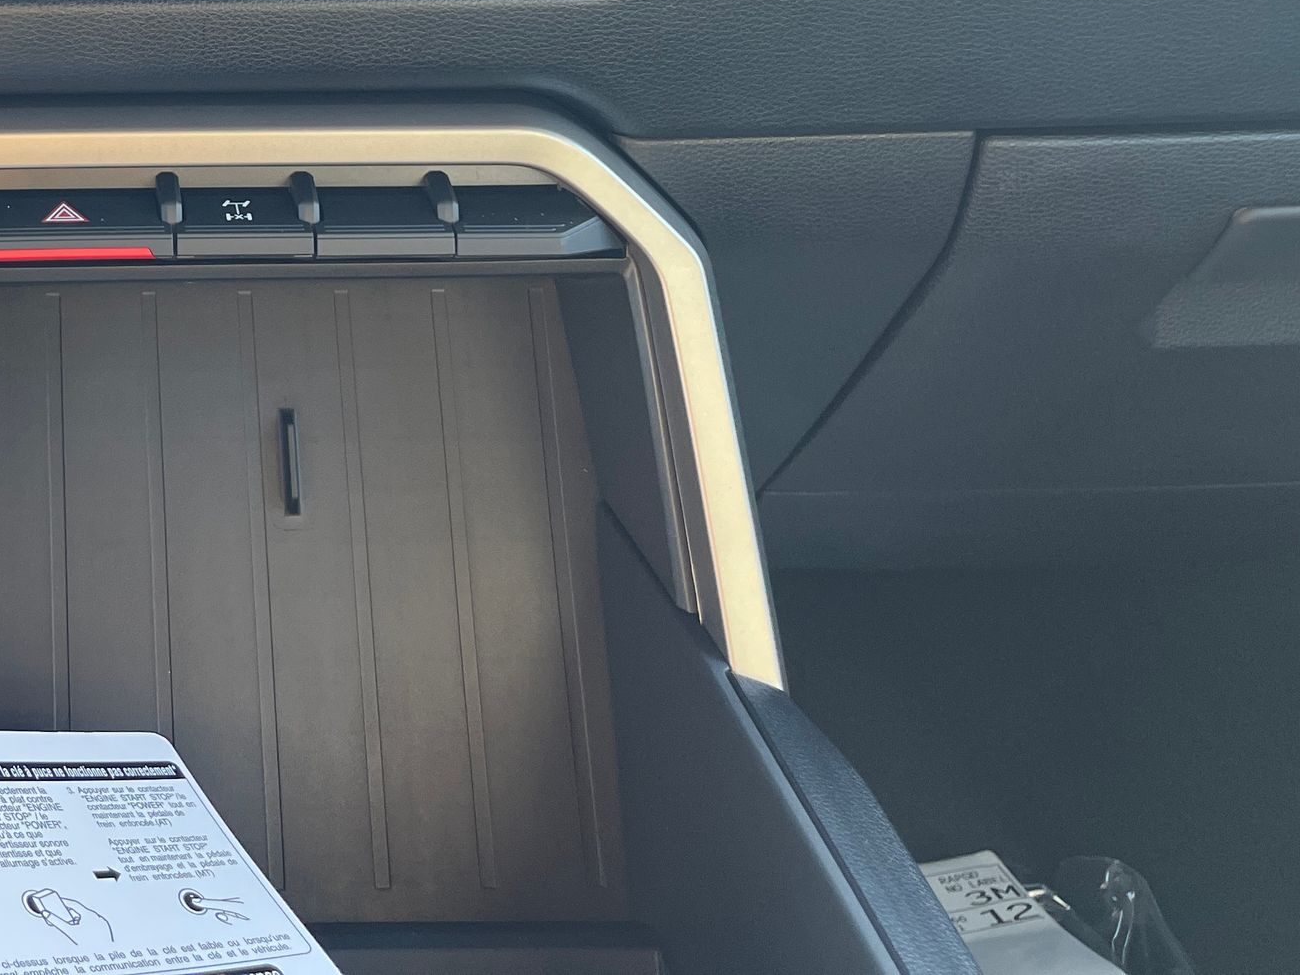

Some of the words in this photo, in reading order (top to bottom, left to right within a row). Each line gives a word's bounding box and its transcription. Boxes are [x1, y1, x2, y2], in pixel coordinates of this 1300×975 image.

[10, 765, 24, 777] clé
[23, 765, 33, 777] à
[32, 767, 54, 780] puce
[53, 767, 66, 777] ne
[63, 765, 108, 778] fonctionne
[107, 767, 124, 780] pas
[965, 885, 1023, 907] 3M
[980, 902, 1038, 926] 12
